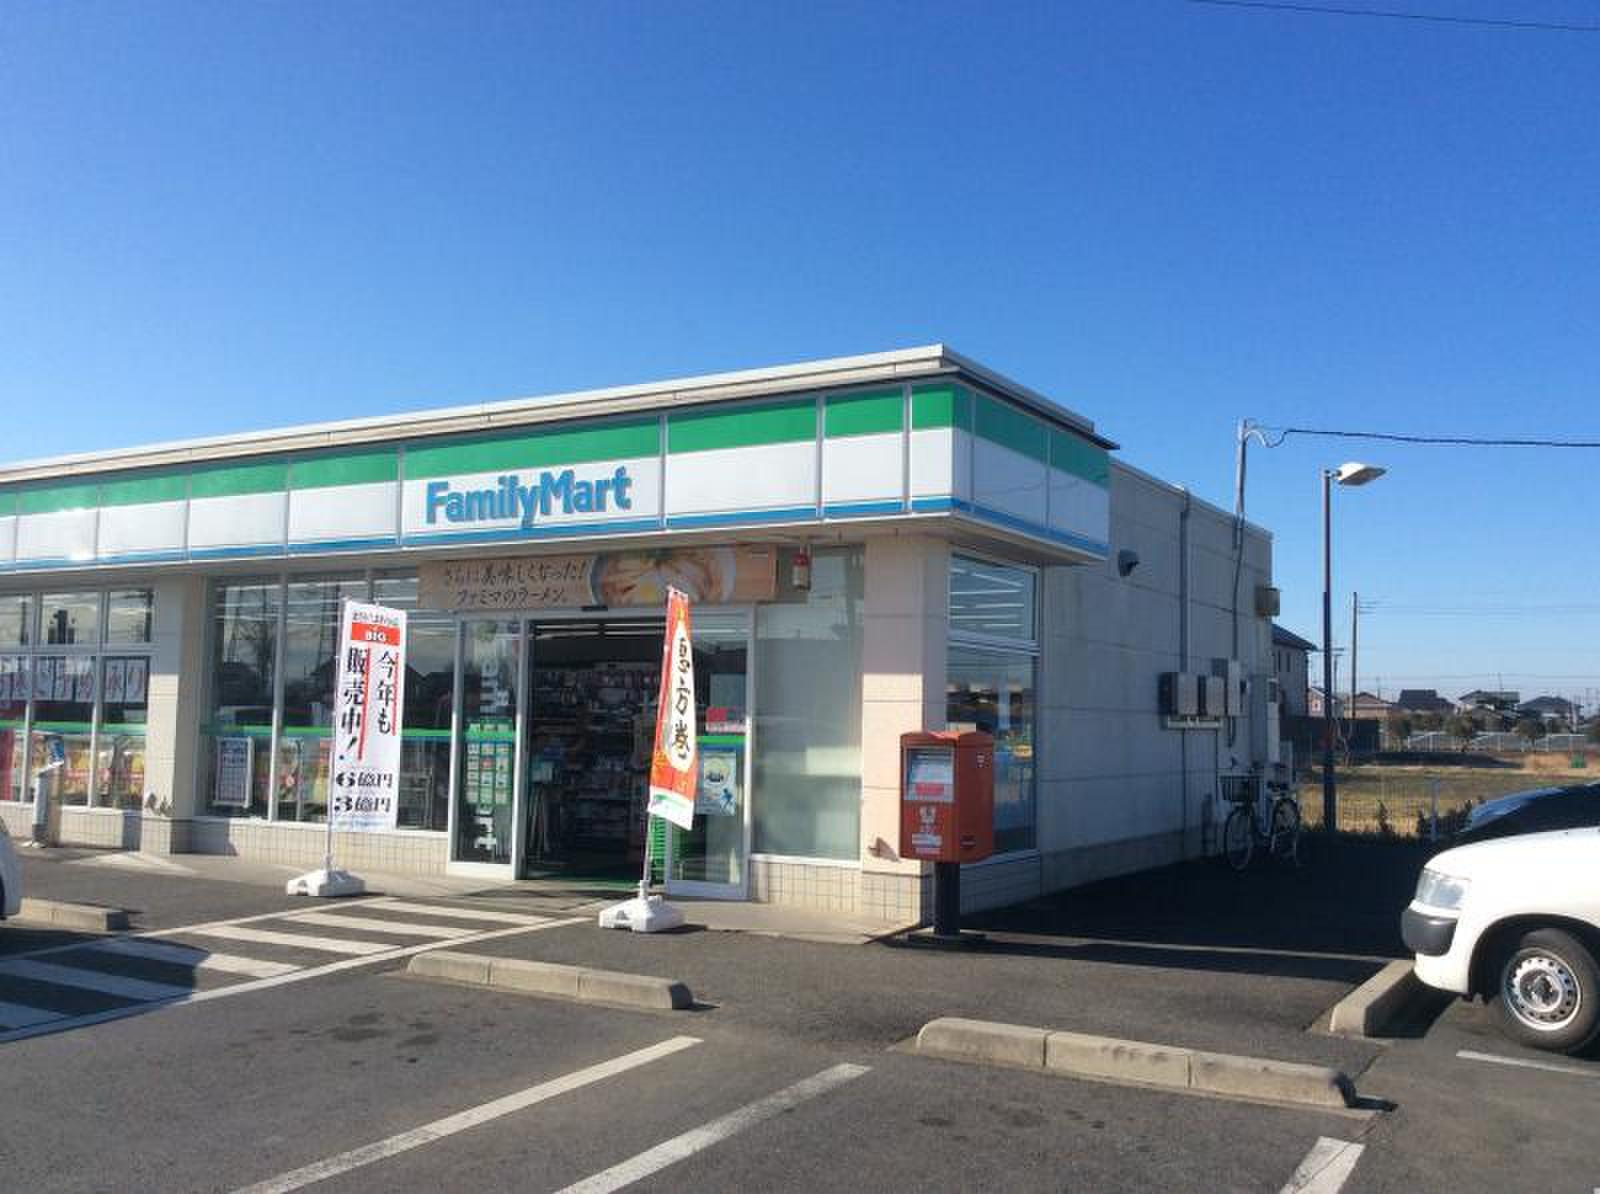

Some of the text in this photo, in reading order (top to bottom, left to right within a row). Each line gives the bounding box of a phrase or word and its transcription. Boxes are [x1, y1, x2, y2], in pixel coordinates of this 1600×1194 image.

[426, 466, 632, 528] FamilyMart
[376, 651, 396, 734] 今年も
[335, 771, 393, 788] 6億円
[334, 796, 391, 812] 3億円
